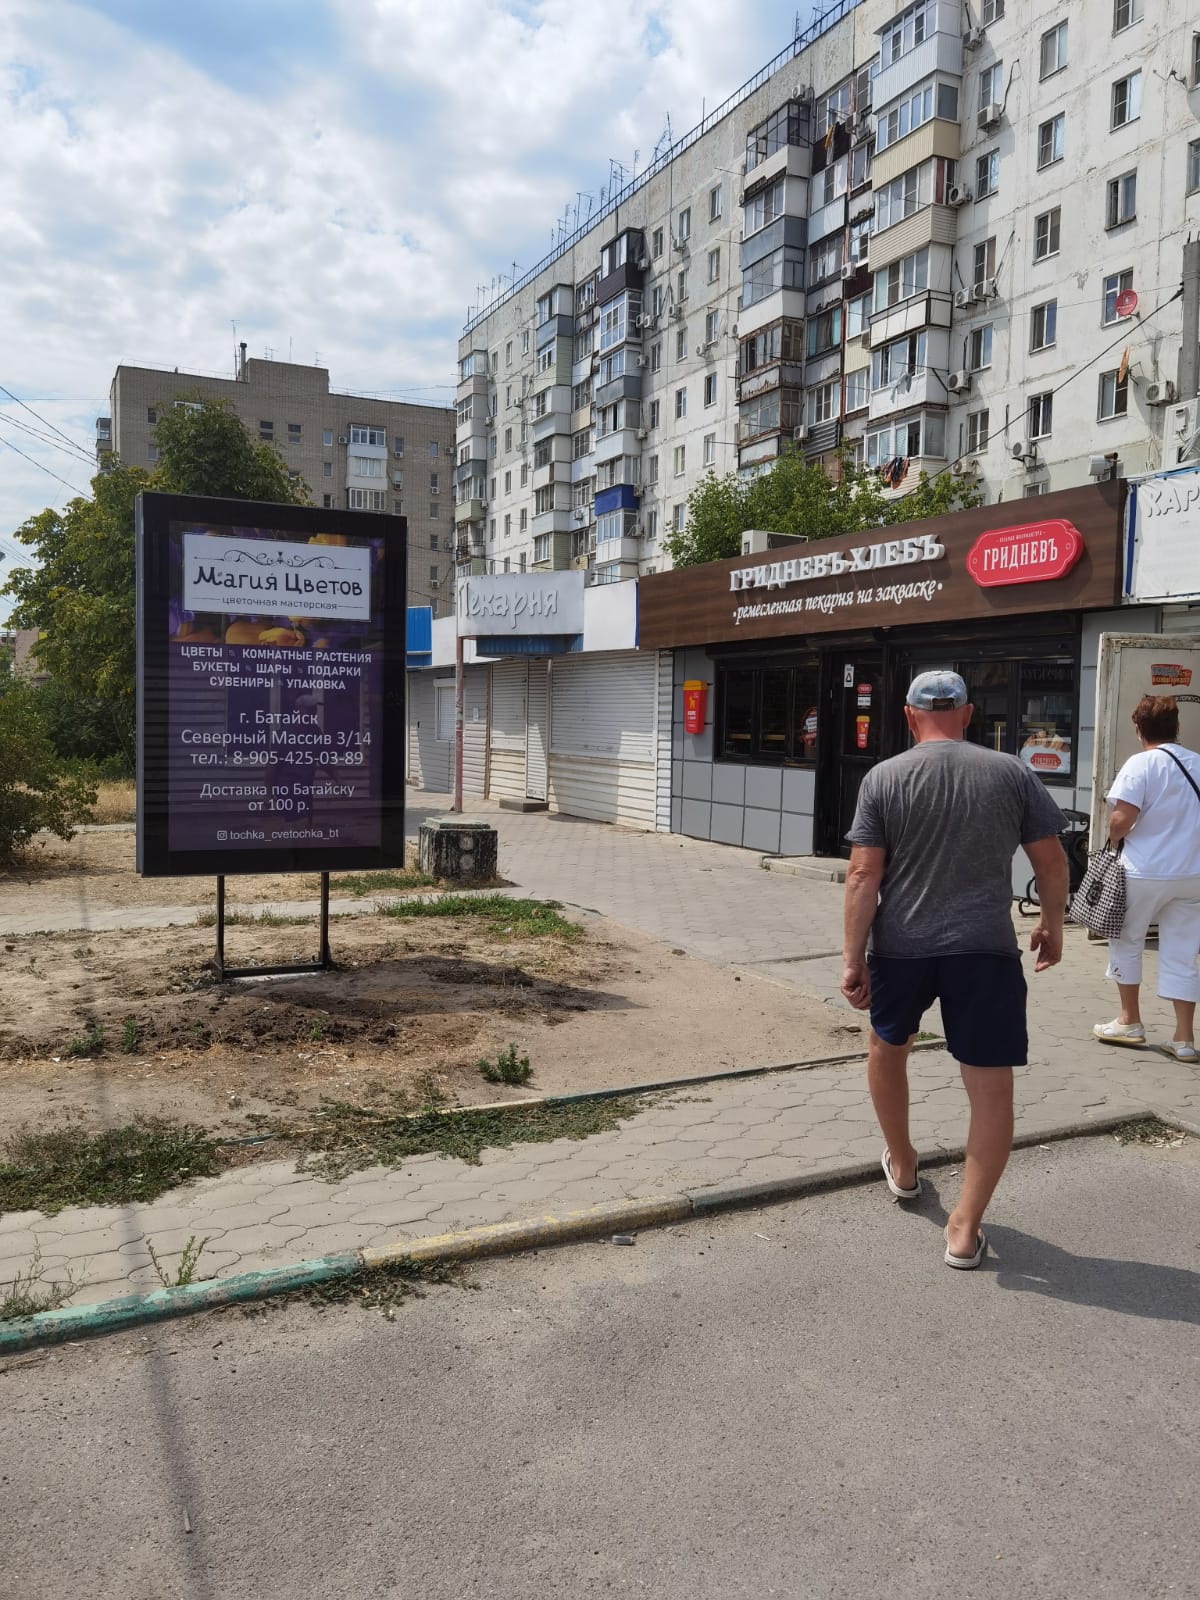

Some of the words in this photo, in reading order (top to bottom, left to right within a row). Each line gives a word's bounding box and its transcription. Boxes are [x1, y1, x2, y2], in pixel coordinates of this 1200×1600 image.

[729, 551, 847, 591] ГРИДНЕВЪ
[849, 534, 946, 572] ХЛЕБЪ
[983, 538, 1059, 572] ГРИДНЕВЪ
[193, 566, 278, 592] Магия
[285, 572, 363, 596] Цветов
[222, 597, 278, 607] цветочная
[280, 600, 337, 610] мастерская
[458, 580, 559, 630] Пекарня
[735, 597, 803, 625] ремесленная
[805, 591, 854, 614] пекарня
[857, 588, 872, 604] на
[875, 579, 936, 605] закваске
[181, 646, 223, 658] ЦВЕТЫ
[242, 649, 312, 661] КОМНАТНЫЕ
[315, 651, 372, 663] РАСТЕНИЯ
[193, 661, 240, 673] БУКЕТЫ
[256, 664, 292, 674] ШАРЫ
[307, 665, 361, 677] ПОДАРКИ
[209, 676, 274, 688] СУВЕНИРЫ
[287, 679, 346, 690] УПАКОВКА
[239, 712, 249, 724] г.
[255, 709, 319, 725] Батайск
[181, 729, 266, 747] Северный
[272, 730, 332, 745] Массив
[336, 731, 372, 748] 3/14
[190, 753, 228, 765] тел.:
[233, 751, 364, 765] 8-905-425-03-89
[200, 784, 267, 798] Доставка
[272, 785, 289, 796] по
[293, 783, 355, 798] Батайску
[248, 801, 263, 811] от
[268, 799, 293, 811] 100
[297, 801, 310, 813] р.
[230, 829, 339, 842] tochka_cvetochka_bt
